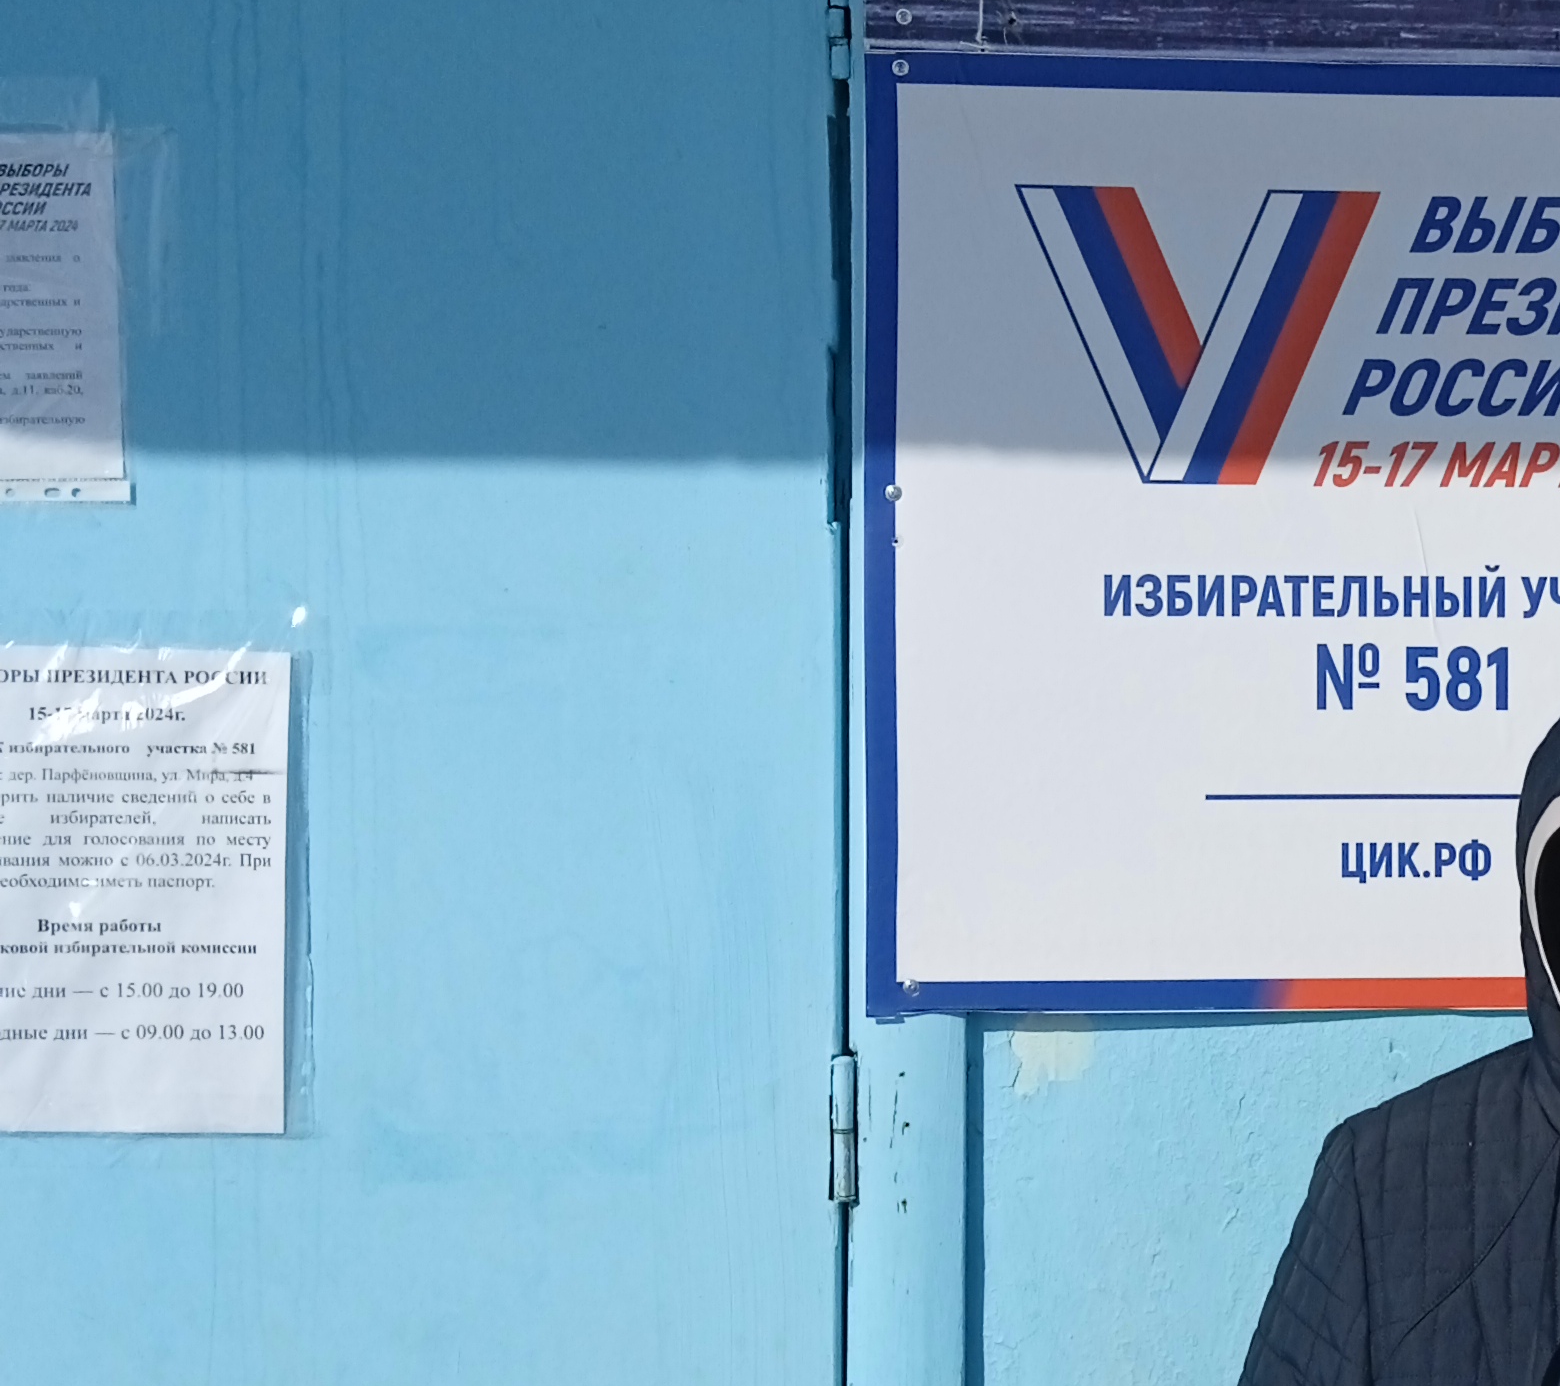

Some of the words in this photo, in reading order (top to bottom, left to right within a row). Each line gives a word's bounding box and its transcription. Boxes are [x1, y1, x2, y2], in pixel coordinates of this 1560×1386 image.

[0, 163, 70, 178] ВЫБОРЫ
[0, 200, 48, 216] ССИИ
[7, 219, 48, 232] МАРТА
[50, 219, 79, 232] 2024
[74, 298, 81, 307] и
[75, 343, 83, 351] и
[1312, 440, 1438, 488] 15-17
[1102, 564, 1506, 619] ИЗБИРАТЕЛЬНЫЙ
[47, 669, 178, 685] ПРЕЗИДЕНТА
[1315, 641, 1381, 711] №
[1404, 645, 1510, 712] 581
[9, 742, 131, 757] избирательного
[147, 744, 208, 757] участка
[231, 742, 256, 755] 581
[9, 771, 36, 783] дер.
[1, 793, 39, 806] рить
[46, 793, 114, 803] наличие
[121, 791, 198, 803] сведений
[205, 794, 215, 803] о
[221, 790, 255, 803] себе
[263, 794, 271, 803] в
[50, 810, 157, 827] избирателей,
[201, 814, 272, 825] написать
[0, 835, 31, 845] ние
[42, 835, 72, 847] для
[83, 835, 185, 846] голосования
[196, 835, 216, 846] по
[226, 835, 271, 850] месту
[0, 856, 50, 867] вания
[59, 856, 114, 867] можно
[120, 856, 129, 867] с
[136, 853, 232, 867] 06.03.2024г.
[240, 853, 271, 871] При
[1340, 838, 1492, 884] ЦИК.РФ
[148, 878, 215, 892] паспорт.
[37, 918, 93, 936] Время
[99, 919, 162, 936] работы
[54, 941, 176, 957] избирательной
[181, 944, 257, 954] комиссии
[32, 987, 66, 999] дни
[100, 986, 109, 998] с
[117, 983, 163, 998] 15.00
[168, 987, 191, 999] до
[198, 983, 244, 998] 19.00
[53, 1028, 88, 1041] дни
[121, 1028, 130, 1040] с
[136, 1024, 184, 1040] 09.00
[190, 1028, 212, 1041] до
[219, 1024, 265, 1040] 13.00
